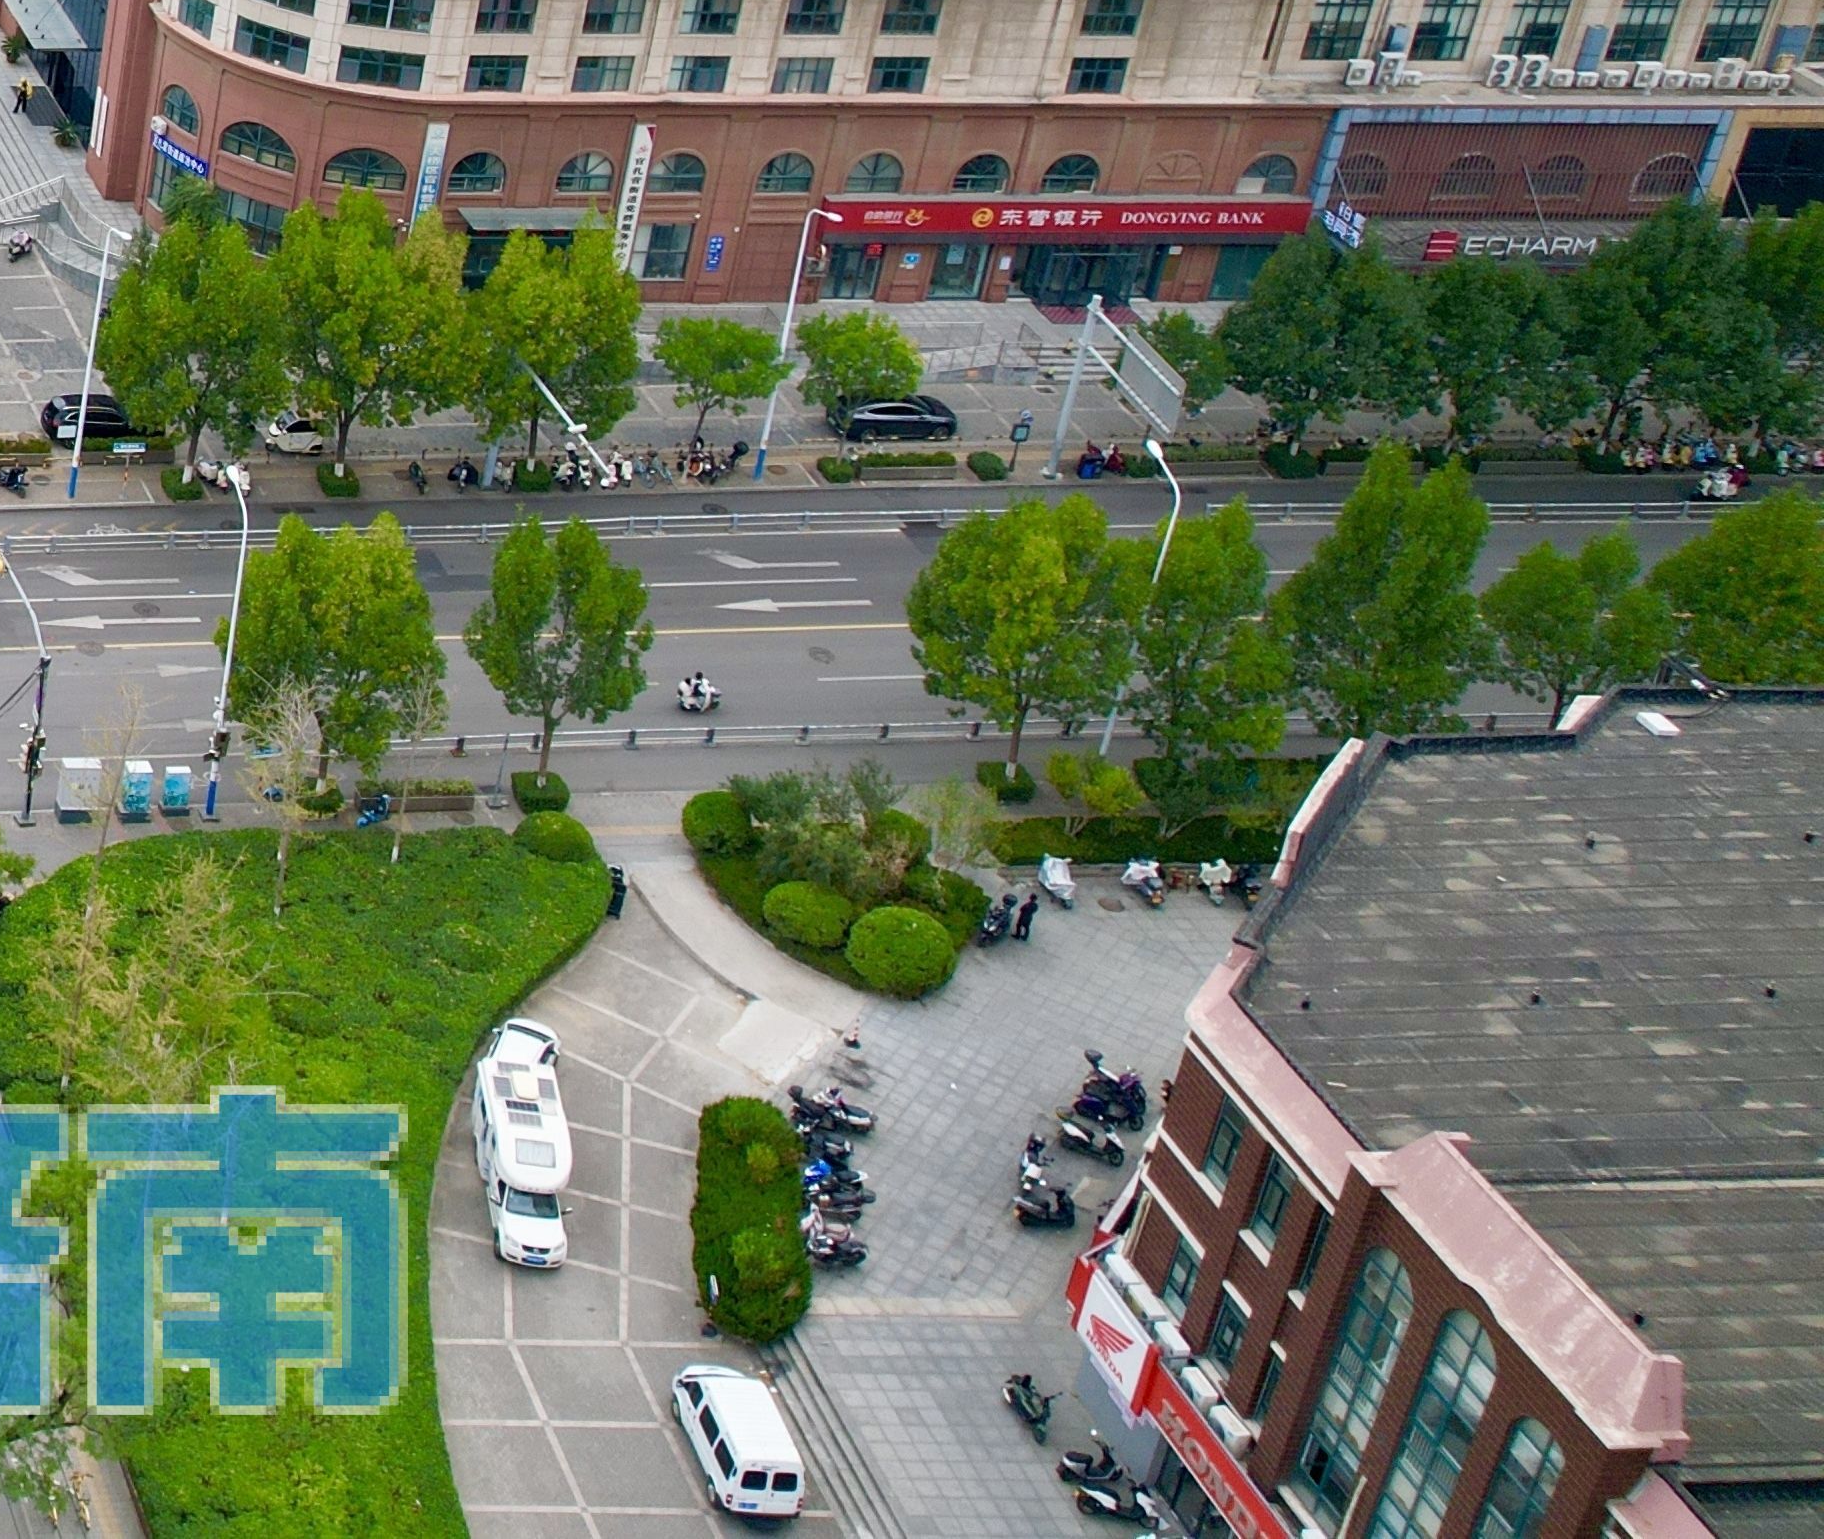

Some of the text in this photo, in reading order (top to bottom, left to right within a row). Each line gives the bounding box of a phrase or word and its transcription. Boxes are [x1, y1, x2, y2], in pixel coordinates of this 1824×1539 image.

[999, 210, 1104, 227] 东营银行
[1120, 211, 1265, 225] DONGYING BANK
[1463, 236, 1598, 257] ECHARM
[1085, 1329, 1124, 1383] HONDA
[1159, 1398, 1269, 1539] HOND
